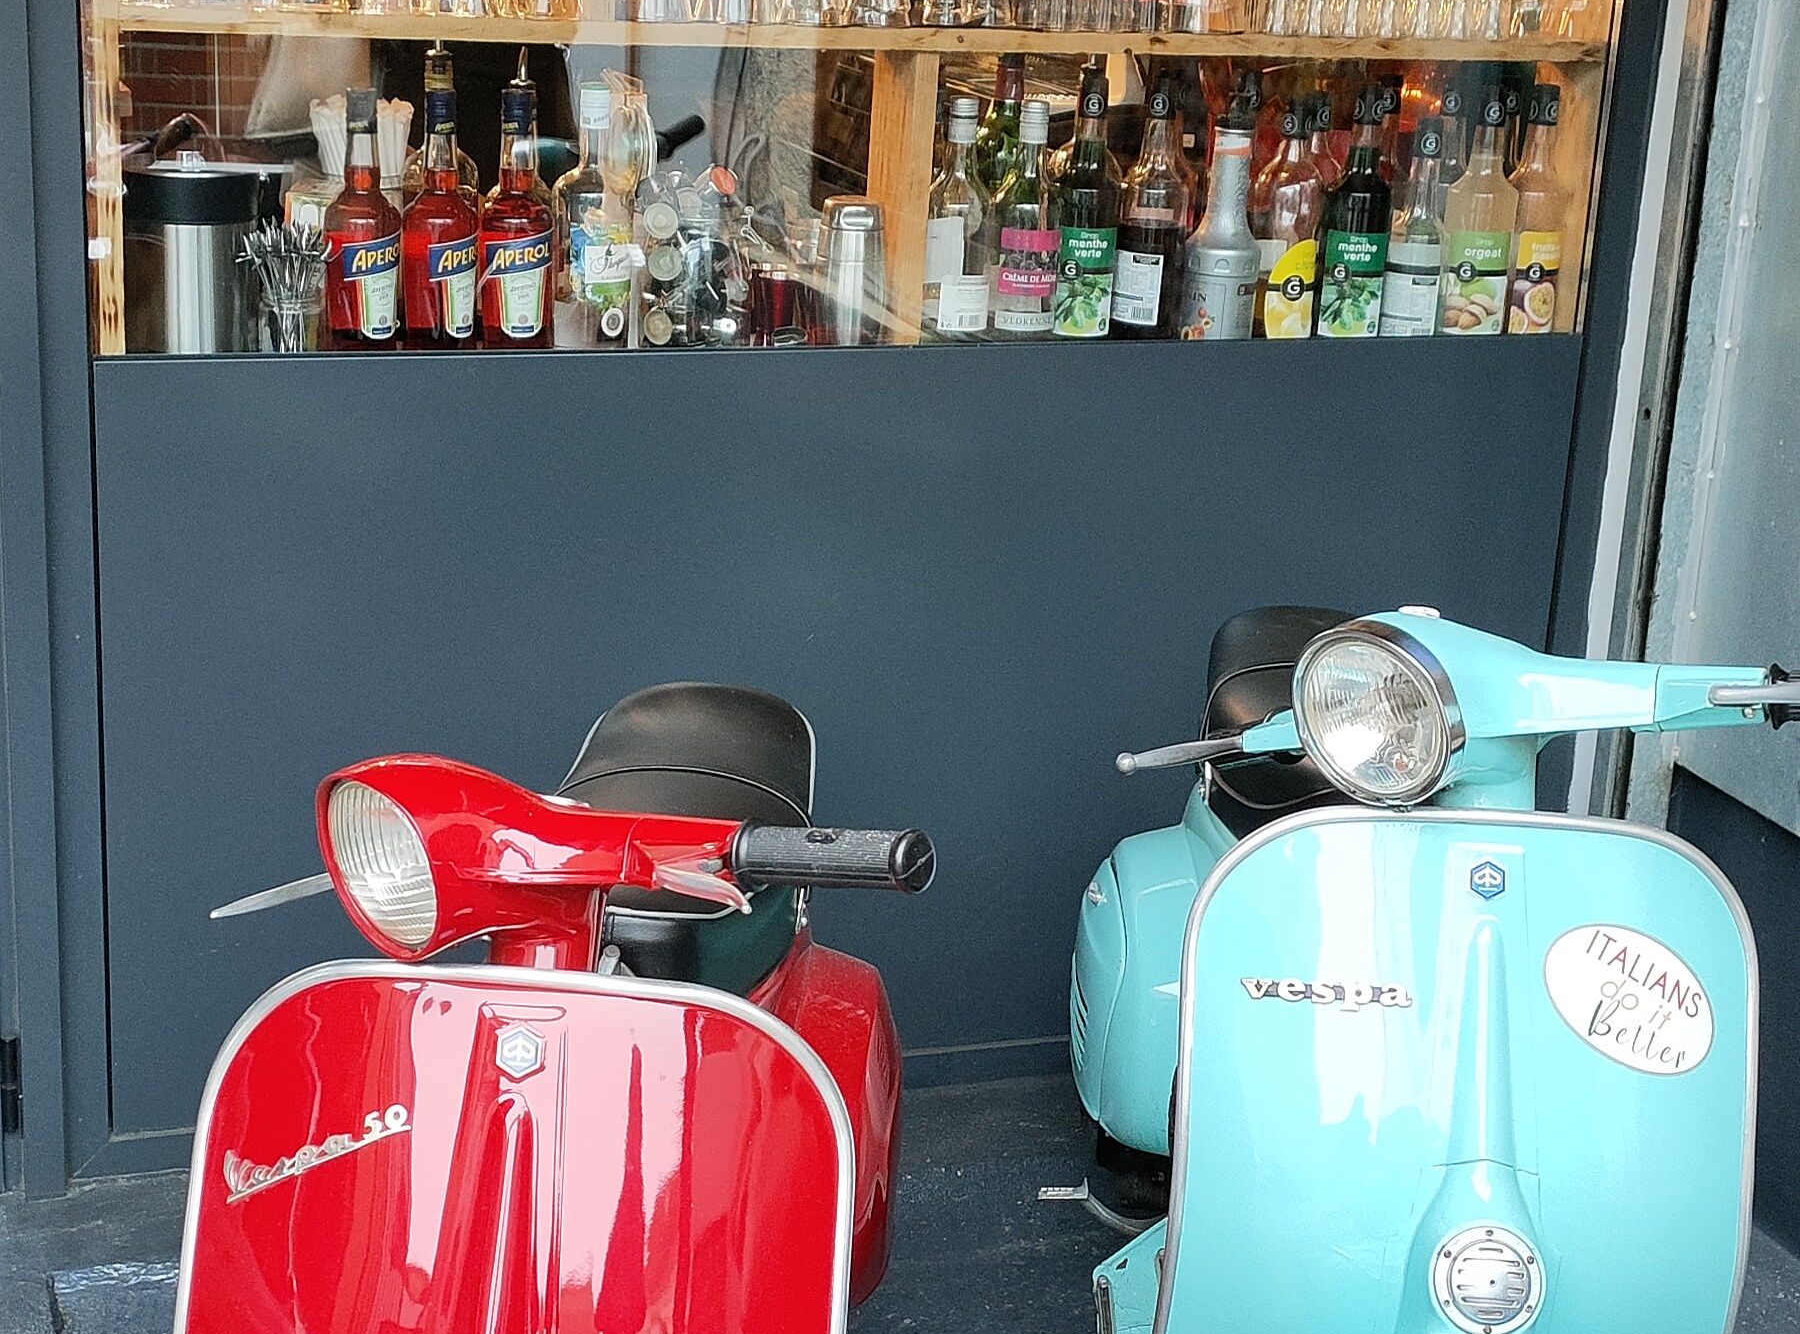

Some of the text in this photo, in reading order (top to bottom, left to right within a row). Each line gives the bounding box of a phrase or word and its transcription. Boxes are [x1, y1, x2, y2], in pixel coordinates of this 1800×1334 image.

[352, 241, 400, 274] APERO
[438, 243, 478, 274] APER
[492, 243, 551, 271] APEROL
[1068, 239, 1109, 250] menthe
[1074, 249, 1103, 259] verte
[1338, 242, 1378, 253] menthe
[1343, 252, 1372, 262] verte
[1464, 247, 1502, 260] orgeat
[1586, 929, 1703, 1018] ITALIANS
[1241, 977, 1413, 1012] vespa
[1600, 979, 1673, 1030] do it
[1588, 999, 1686, 1069] Better
[223, 1104, 411, 1200] Vespa 50
